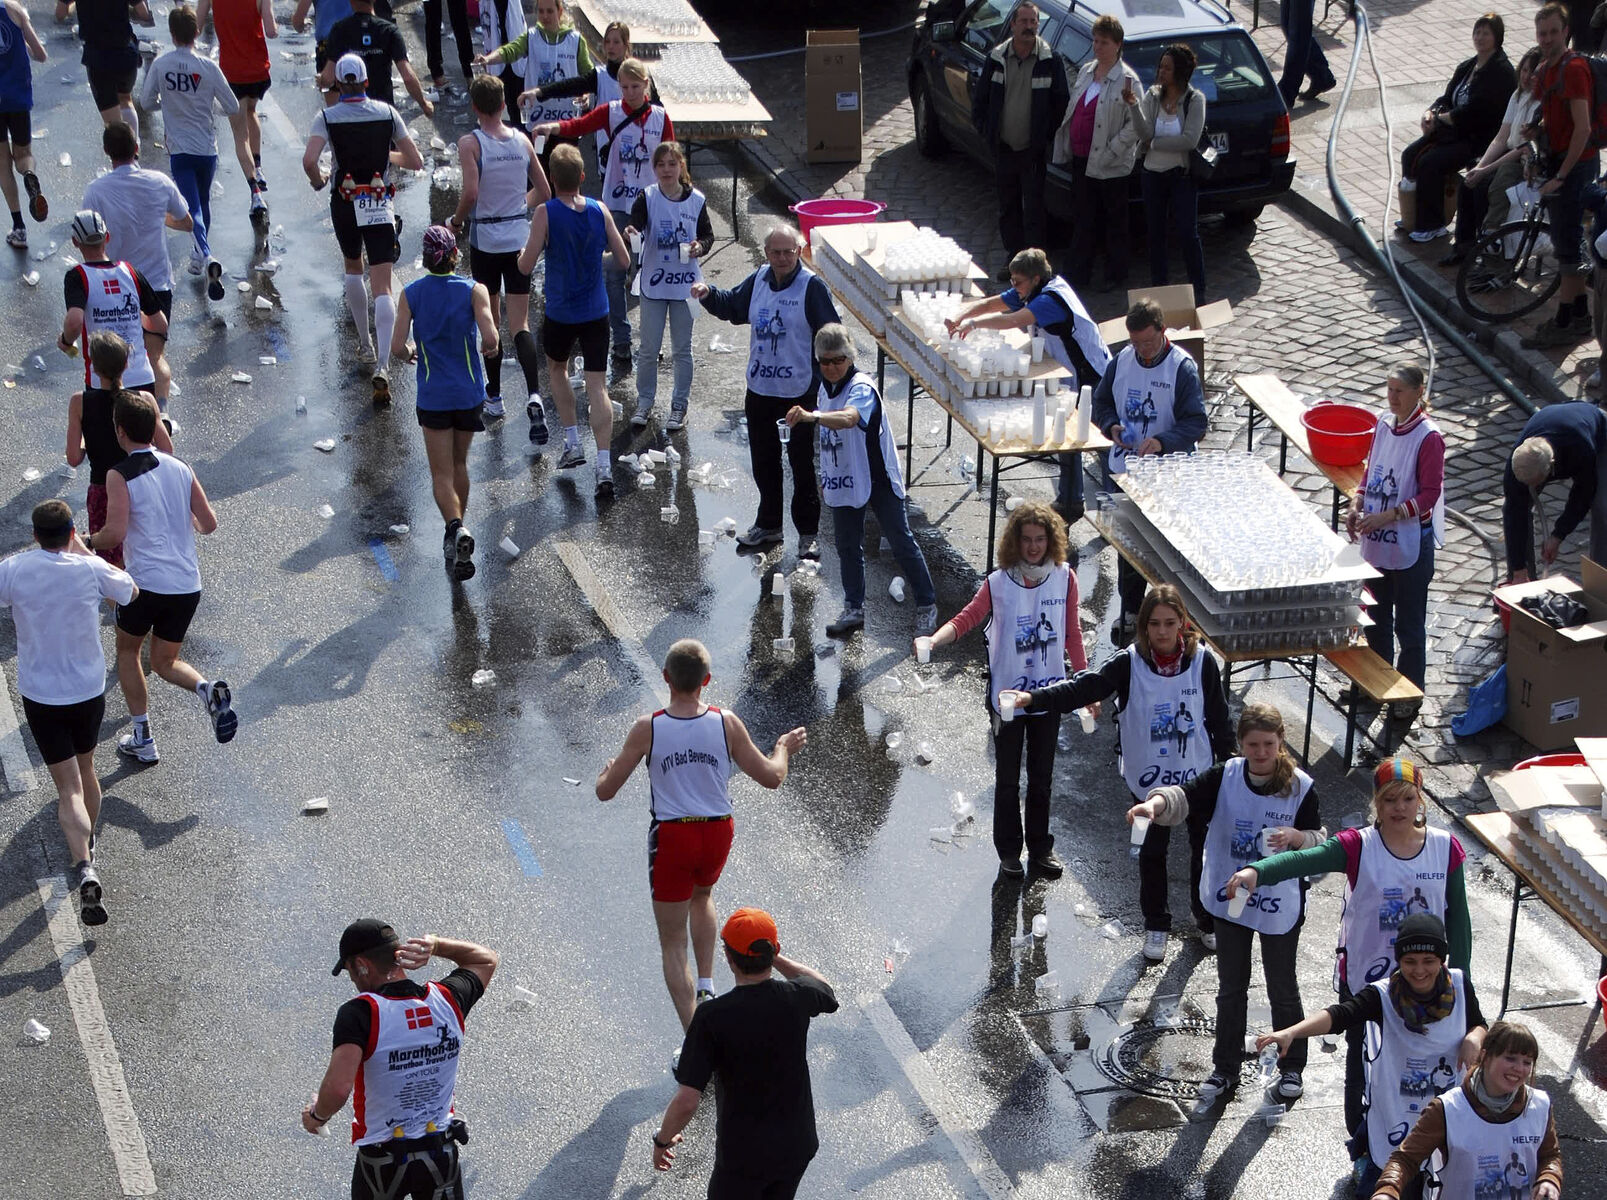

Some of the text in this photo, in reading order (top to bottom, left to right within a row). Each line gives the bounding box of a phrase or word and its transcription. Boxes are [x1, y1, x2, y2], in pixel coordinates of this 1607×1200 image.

[165, 71, 202, 93] SBV
[543, 107, 573, 121] asics
[665, 271, 696, 285] asics
[759, 364, 793, 379] asics
[1367, 528, 1398, 544] sics
[661, 748, 719, 775] MTV Bad Bevensen
[1416, 872, 1446, 880] HELFER
[1246, 892, 1282, 914] sics
[388, 1059, 424, 1072] Marathon
